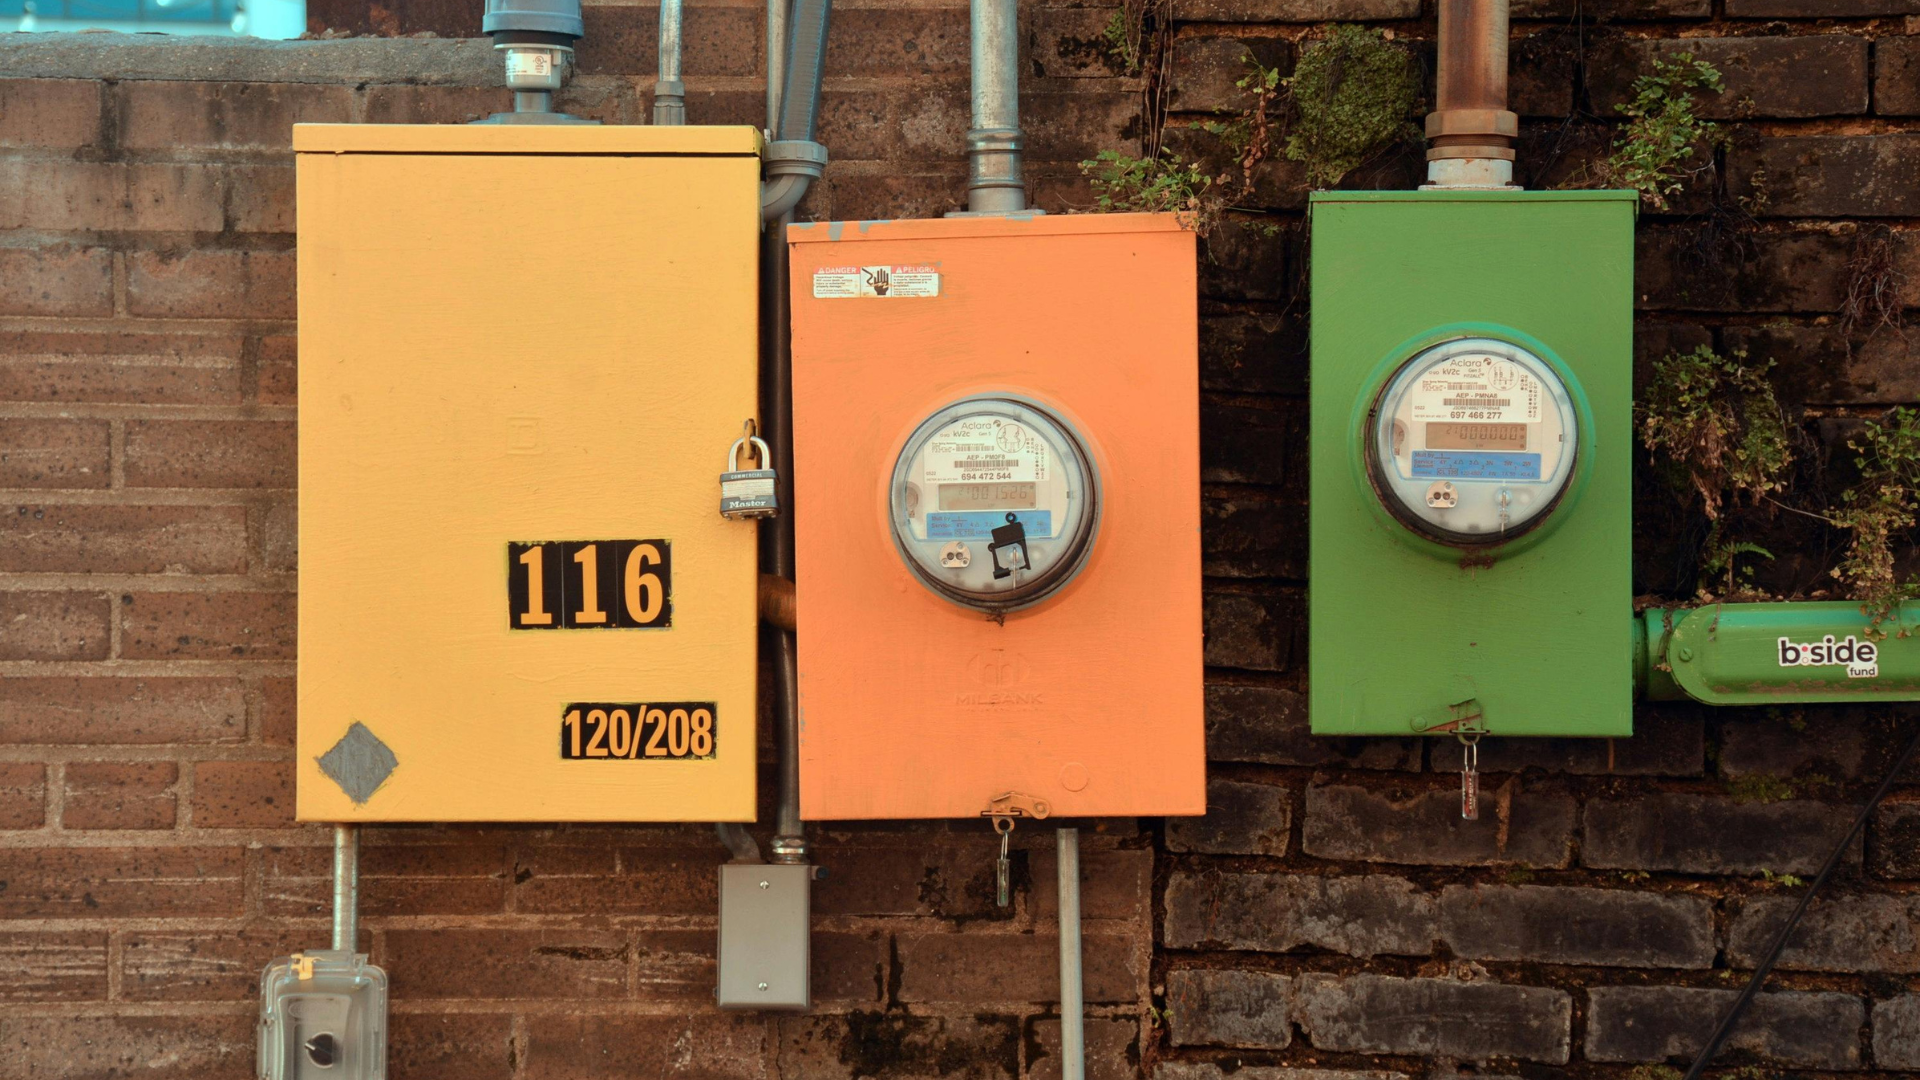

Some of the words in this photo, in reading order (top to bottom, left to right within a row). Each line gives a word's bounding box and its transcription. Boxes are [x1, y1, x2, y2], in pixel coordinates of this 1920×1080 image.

[1450, 359, 1482, 367] Aclara
[962, 422, 992, 430] Aclara
[730, 500, 766, 508] Master
[520, 544, 663, 624] 116
[1850, 667, 1876, 676] fund
[565, 704, 712, 758] 120/208
